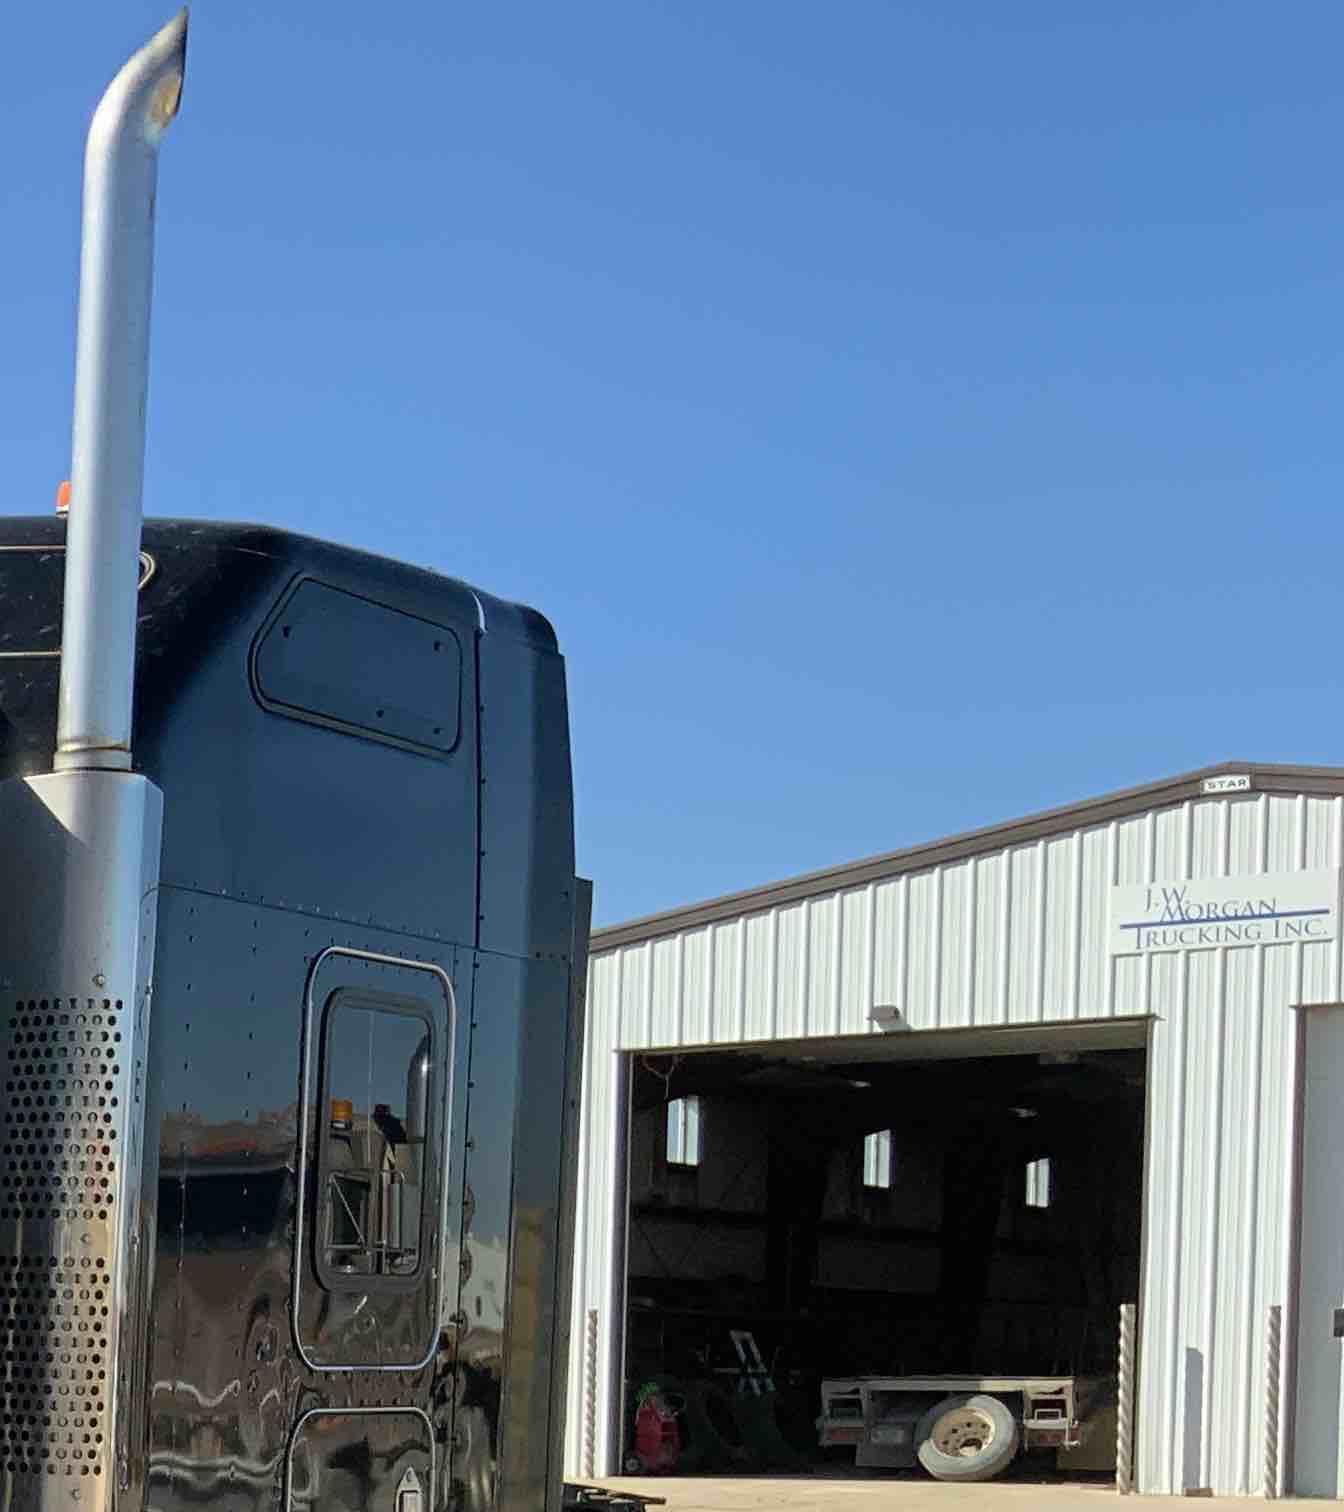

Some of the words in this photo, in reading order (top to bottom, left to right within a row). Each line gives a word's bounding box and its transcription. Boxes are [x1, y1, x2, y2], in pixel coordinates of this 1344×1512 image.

[1207, 778, 1247, 791] STAR
[1161, 898, 1278, 922] MORGAN
[1135, 922, 1262, 950] TRUCKING
[1272, 917, 1328, 940] INC.
